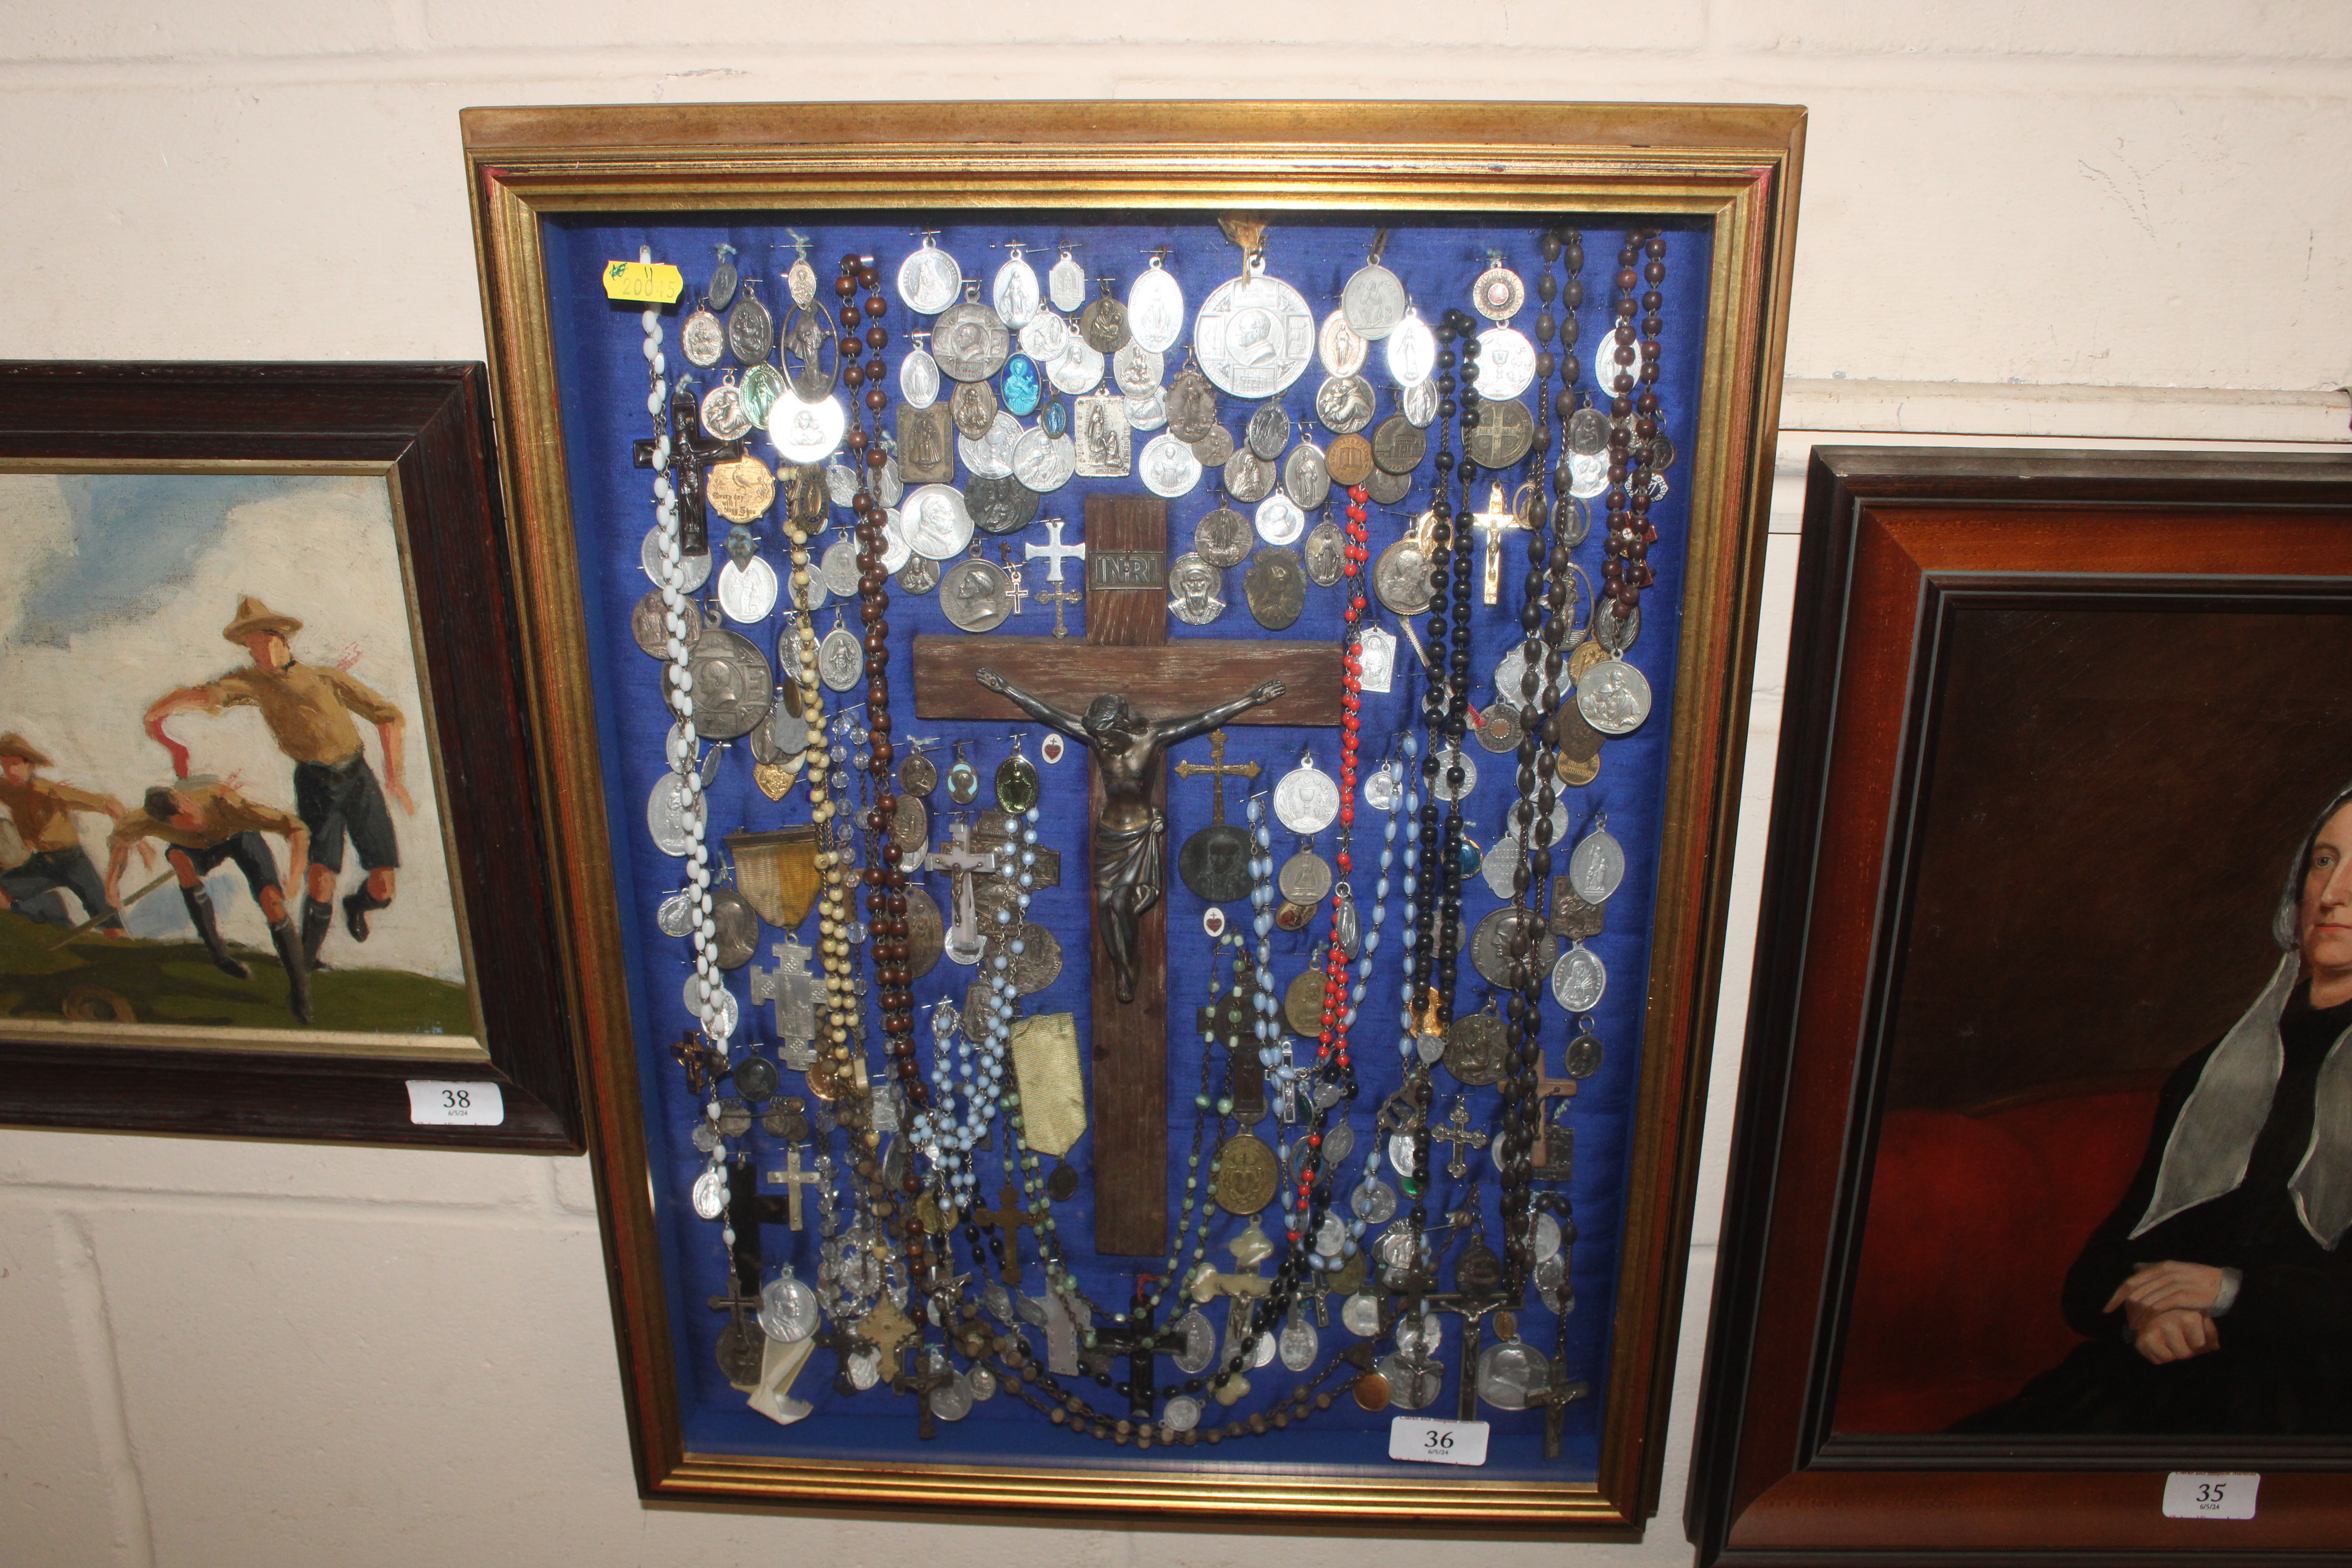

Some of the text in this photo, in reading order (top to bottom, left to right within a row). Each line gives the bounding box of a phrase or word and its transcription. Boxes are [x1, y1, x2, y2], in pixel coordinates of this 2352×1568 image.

[622, 277, 675, 298] 20045
[1096, 556, 1157, 584] INRI
[1559, 766, 1594, 777] COMMUNION
[1568, 760, 1589, 768] FIRST
[442, 1089, 471, 1108] 38
[1424, 1430, 1454, 1448] 36
[2196, 1483, 2227, 1502] 35
